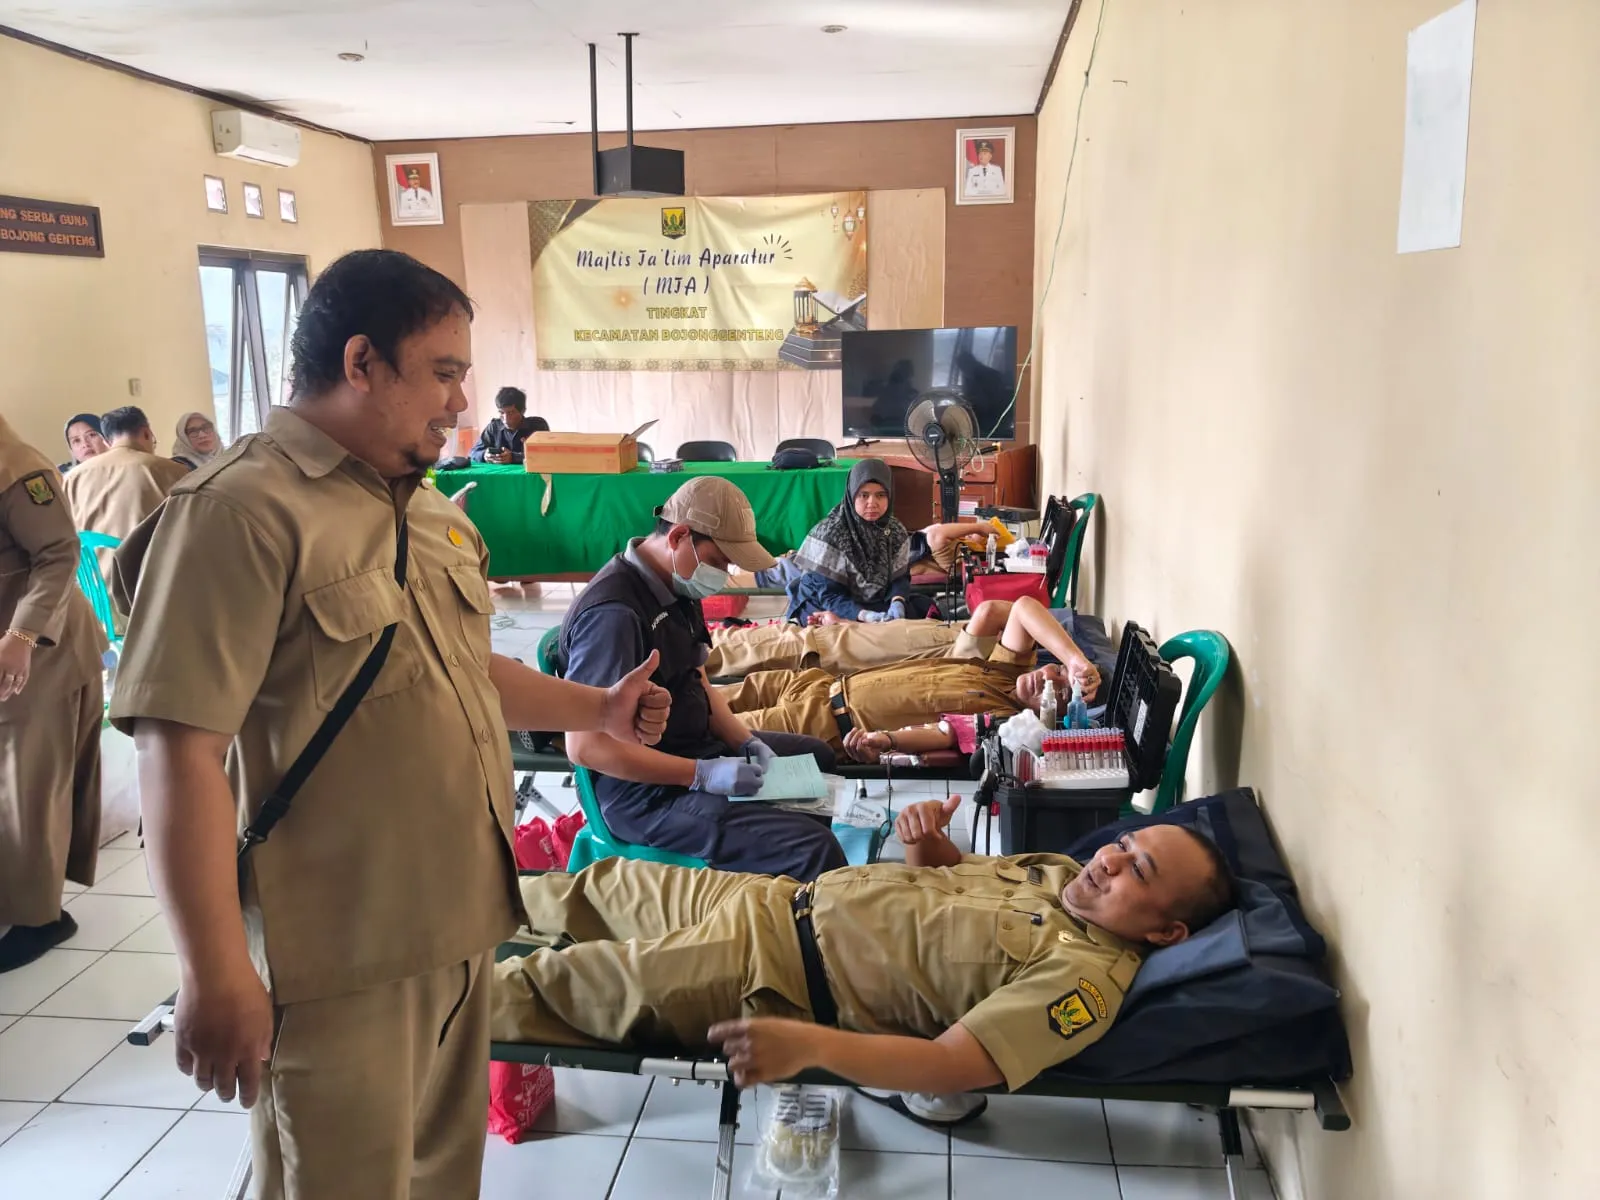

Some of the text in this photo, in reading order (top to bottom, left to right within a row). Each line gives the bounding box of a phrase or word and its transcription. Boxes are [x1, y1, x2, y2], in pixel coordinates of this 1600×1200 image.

[20, 210, 56, 224] SERBA
[59, 214, 88, 227] GUNA
[1, 229, 96, 247] BOJONG GENTENG
[576, 249, 631, 271] Majlis
[698, 247, 775, 270] Aparatur
[646, 306, 708, 320] TINGKAT
[573, 328, 785, 342] KECAMATAN BOJONGGENTENG
